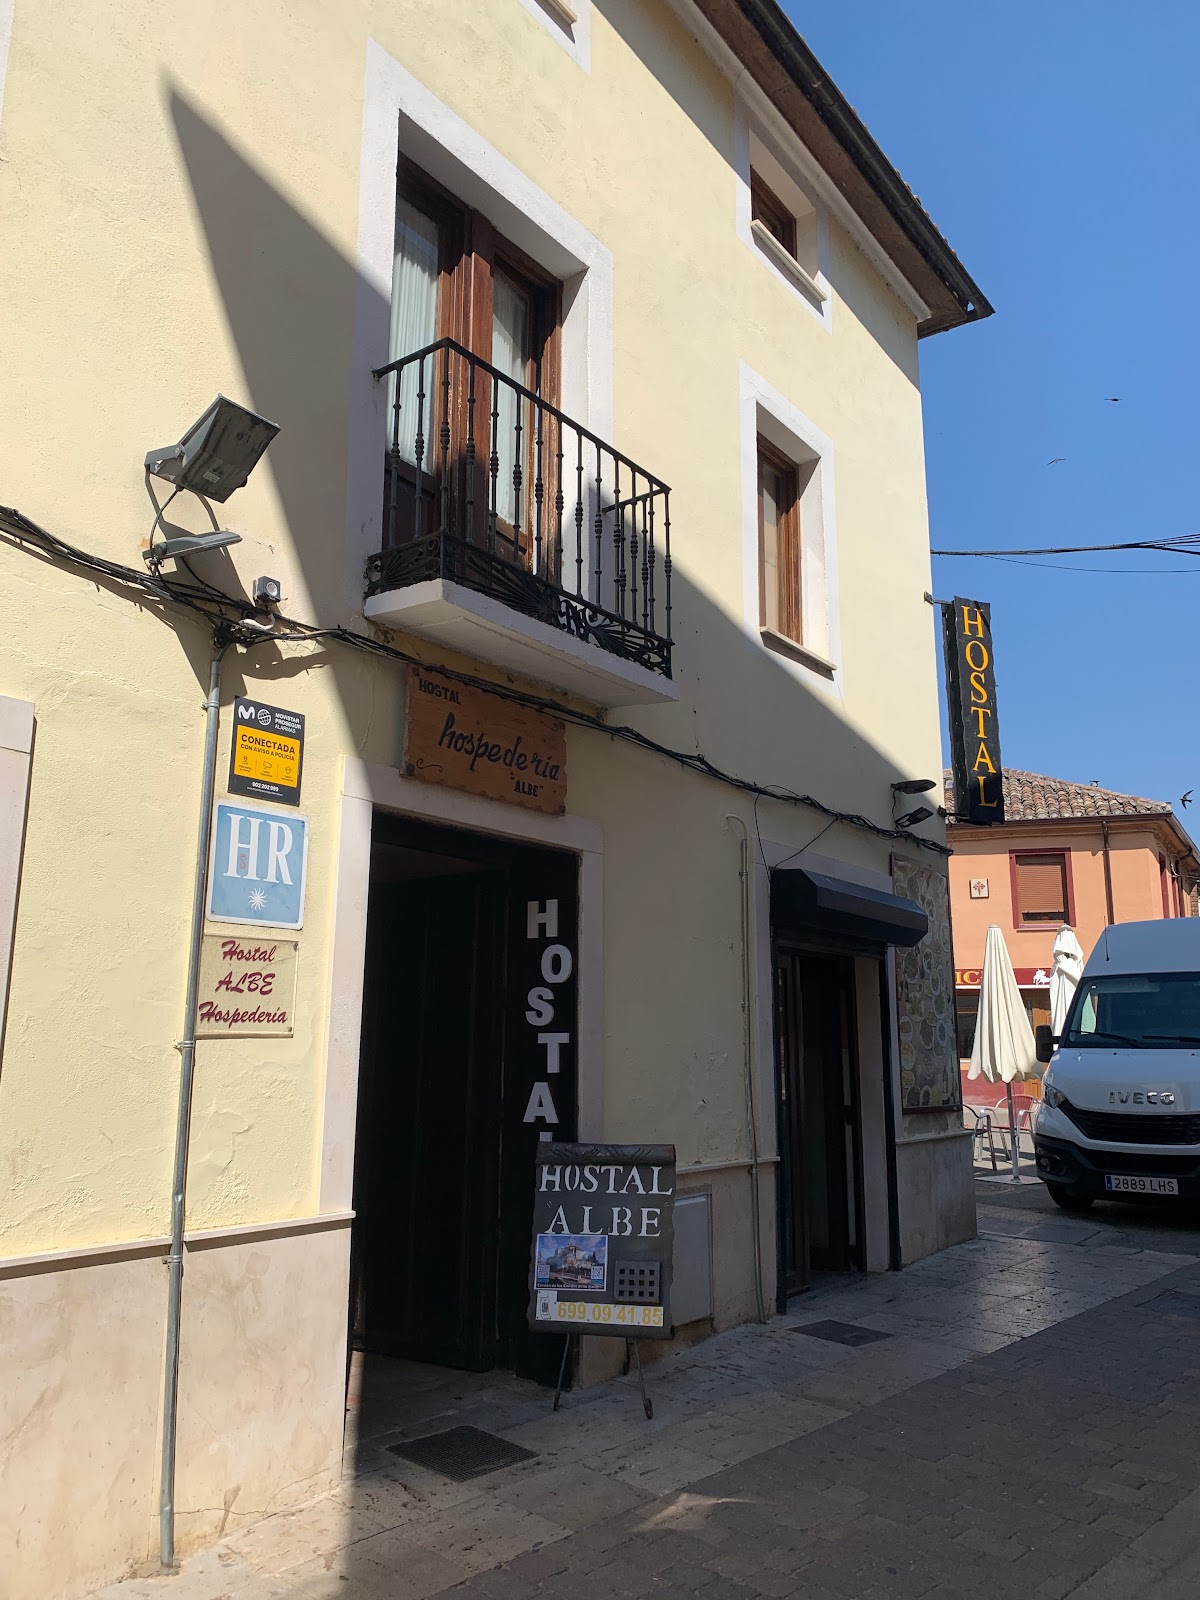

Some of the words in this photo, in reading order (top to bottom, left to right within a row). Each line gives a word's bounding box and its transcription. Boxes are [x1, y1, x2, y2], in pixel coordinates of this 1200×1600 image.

[419, 678, 461, 705] HOSTAL
[961, 605, 997, 807] HOSTAL
[275, 713, 299, 723] MOVISTAR
[275, 718, 301, 730] PROSEGUR
[275, 724, 296, 733] ALARMAS
[241, 734, 295, 754] CONECTADA
[241, 744, 253, 752] CON
[254, 746, 270, 755] AVISO
[275, 752, 295, 761] POLICÍA
[221, 940, 277, 963] Hostal
[215, 971, 276, 996] ALBE
[1109, 1091, 1176, 1106] IVECO
[538, 1164, 673, 1196] HOSTAL
[1114, 1177, 1146, 1191] 2889
[1150, 1179, 1175, 1193] LHS
[557, 1301, 587, 1321] 699
[592, 1303, 612, 1322] 09
[616, 1305, 636, 1324] 41
[641, 1307, 662, 1326] 85
